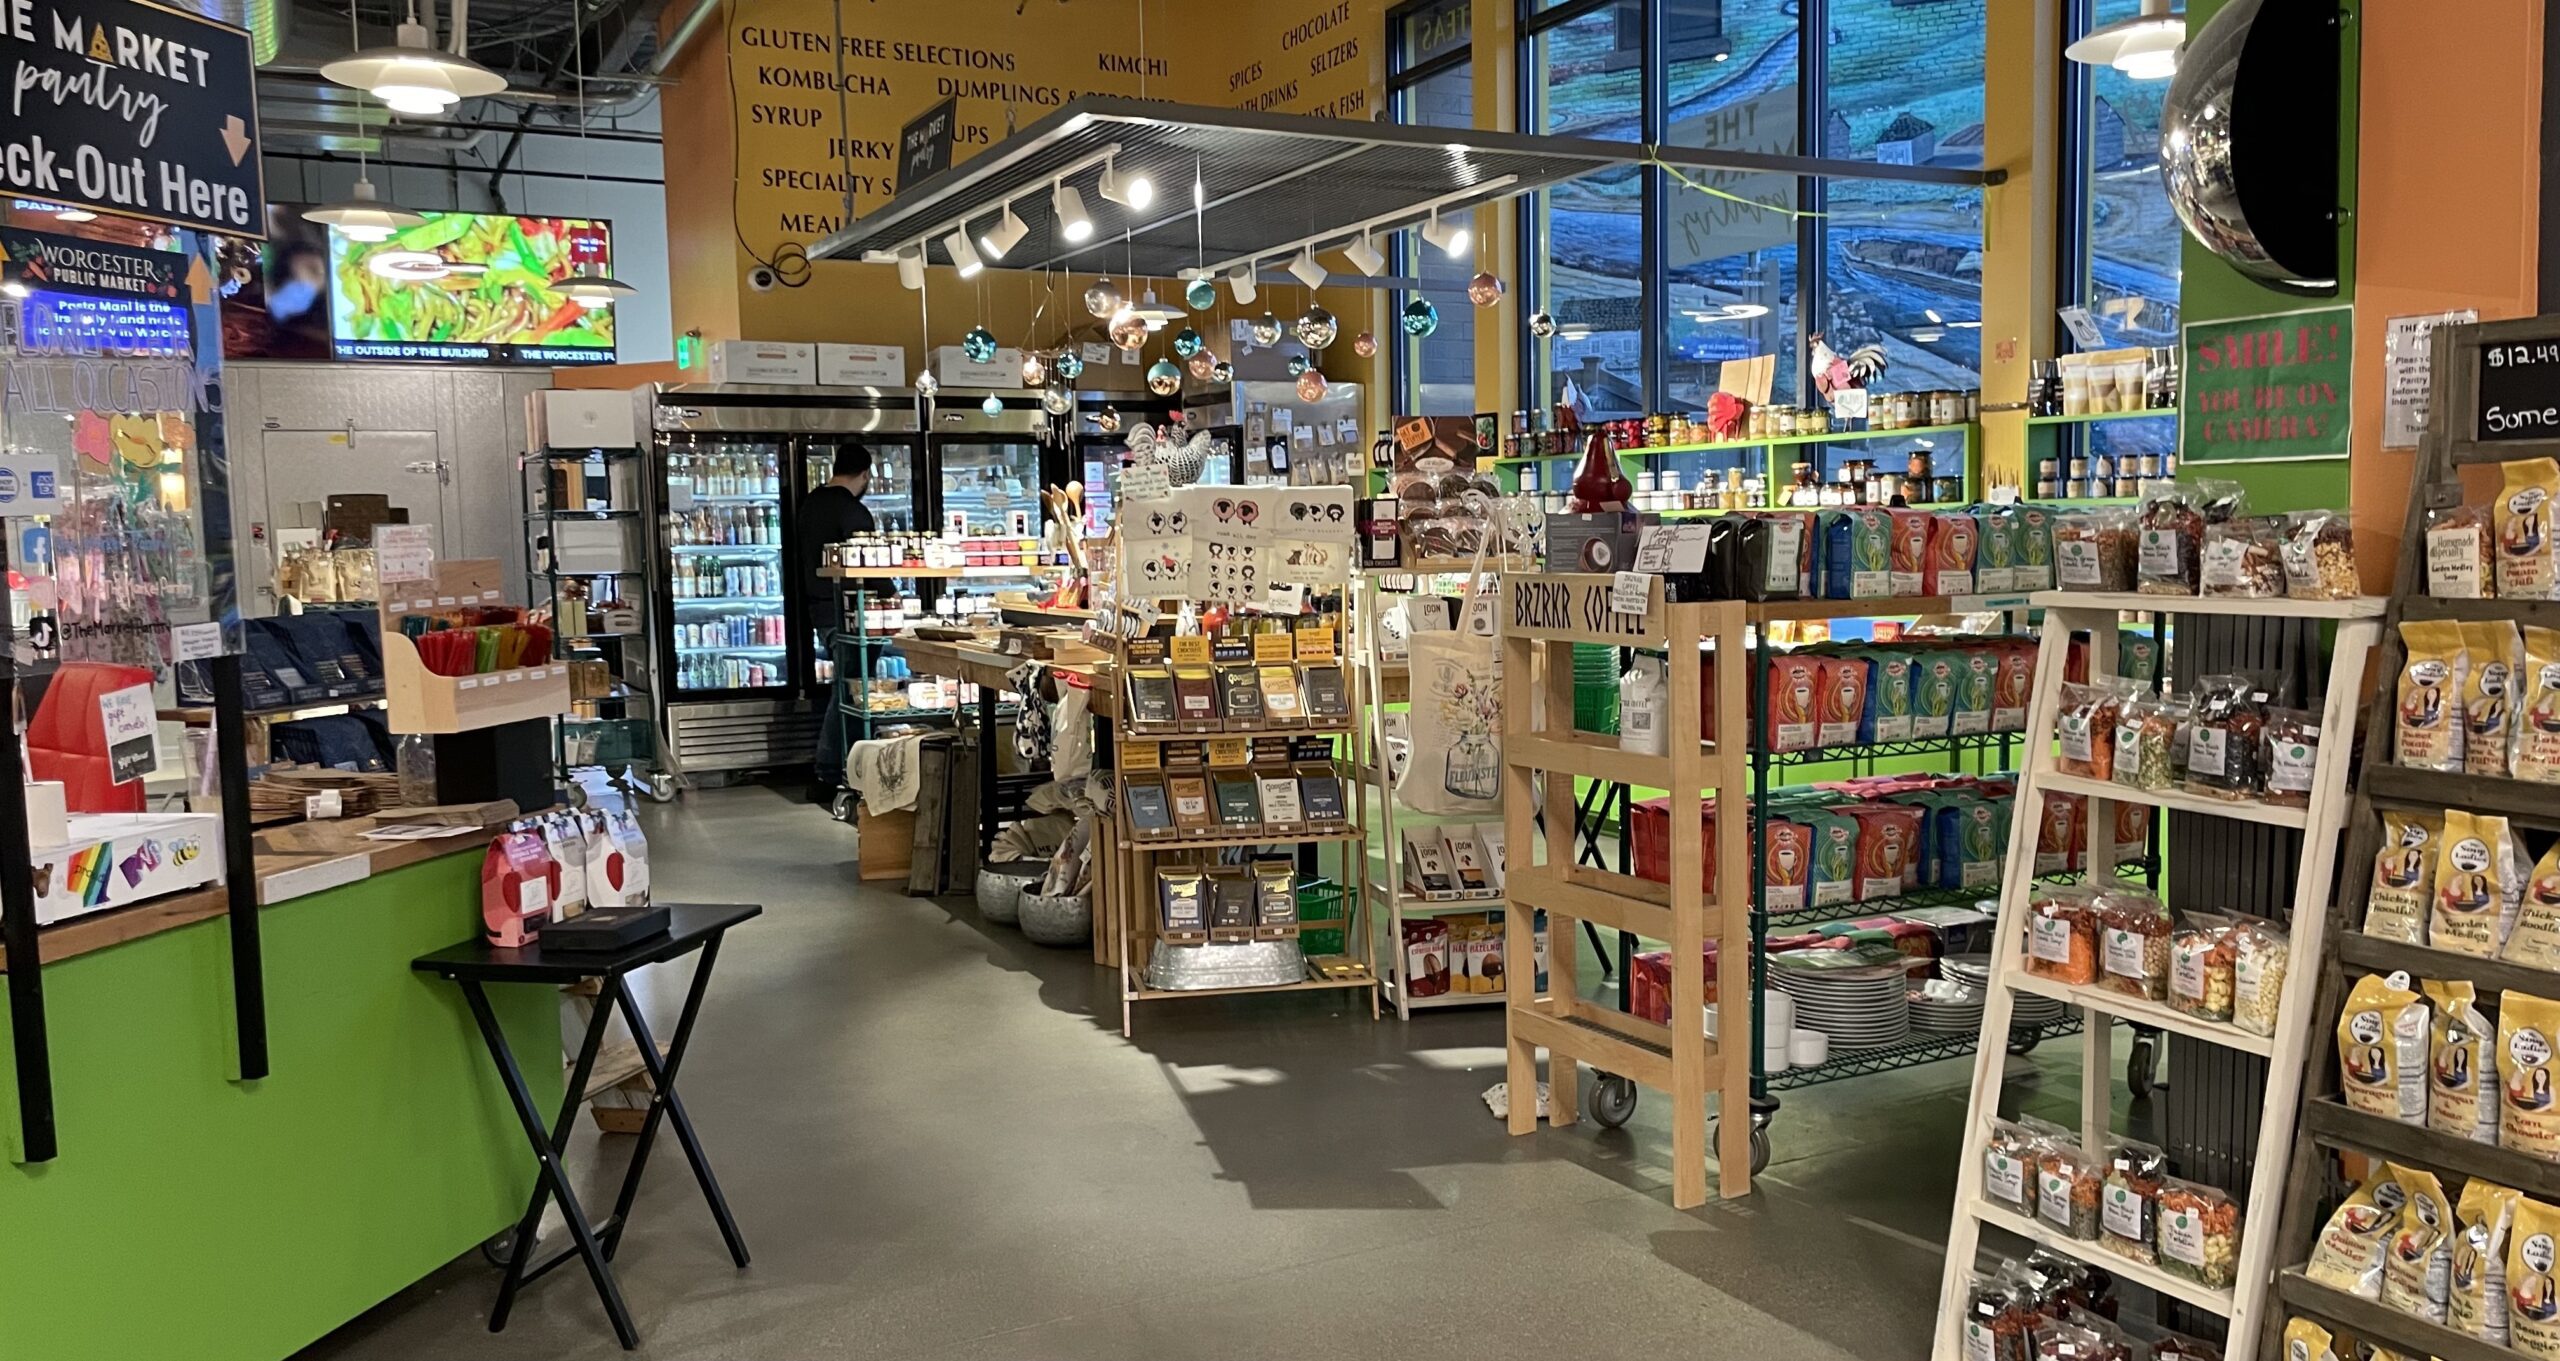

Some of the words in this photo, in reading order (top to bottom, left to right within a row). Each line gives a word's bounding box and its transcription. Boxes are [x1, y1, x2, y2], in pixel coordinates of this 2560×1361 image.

[1282, 1, 1350, 51] CHOCOLATE
[742, 27, 830, 53] GLUTEN
[841, 37, 886, 59] FREE
[894, 43, 1015, 71] SELECTIONS
[1310, 37, 1358, 77] SELTZERS
[1099, 53, 1169, 77] KIMCHI
[1229, 60, 1263, 92] SPICES
[14, 58, 169, 148] pantry
[938, 78, 1060, 106] DUMPLINGS
[1261, 79, 1298, 108] DRINKS
[1340, 88, 1364, 115] FISH
[752, 104, 823, 127] SYRUP
[829, 138, 894, 161] JERKY
[0, 135, 148, 207] ck-Out
[160, 161, 249, 226] Here
[763, 169, 873, 194] SPECIALTY
[35, 238, 160, 282] WORCESTER
[54, 268, 96, 287] PUBLIC
[99, 274, 147, 293] MARKET
[356, 346, 400, 356] OUTSIDE
[402, 347, 417, 357] OF
[419, 347, 438, 357] THE
[441, 348, 489, 358] BUILDING
[520, 350, 541, 360] THE
[543, 351, 602, 361] WORCESTER
[2197, 323, 2338, 373] SMILE!
[2392, 387, 2419, 396] before
[2401, 377, 2427, 386] Pantry
[2486, 406, 2560, 432] Some
[2432, 564, 2450, 573] Garden
[2451, 564, 2473, 573] Medley
[2444, 573, 2458, 582] Soup
[1423, 604, 1441, 616] LOON
[1515, 582, 1571, 629] BRZRKR
[2455, 851, 2488, 863] Ladies
[2460, 844, 2487, 856] Soup
[2514, 1323, 2546, 1338] Bean
